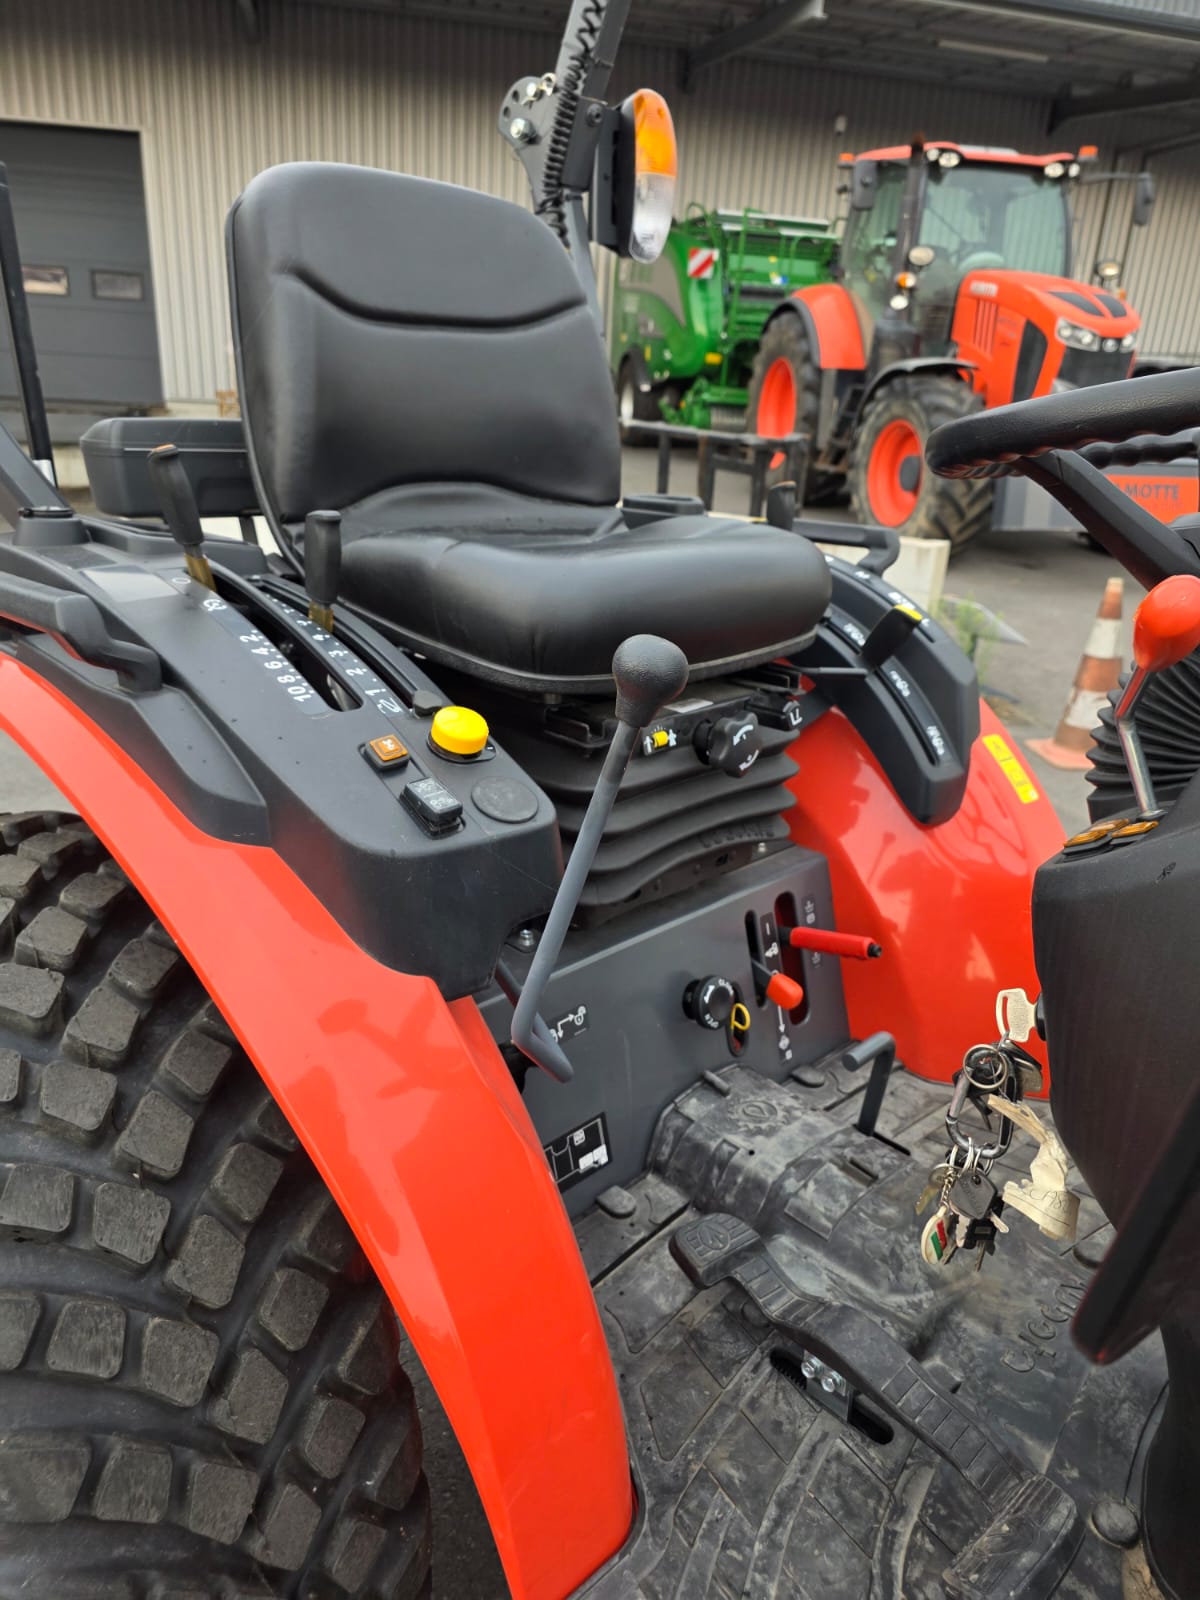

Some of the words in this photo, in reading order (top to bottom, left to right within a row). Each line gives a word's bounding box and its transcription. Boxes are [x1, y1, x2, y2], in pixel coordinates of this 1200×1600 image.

[345, 667, 364, 677] 2
[277, 674, 296, 684] 8
[287, 685, 312, 702] 10
